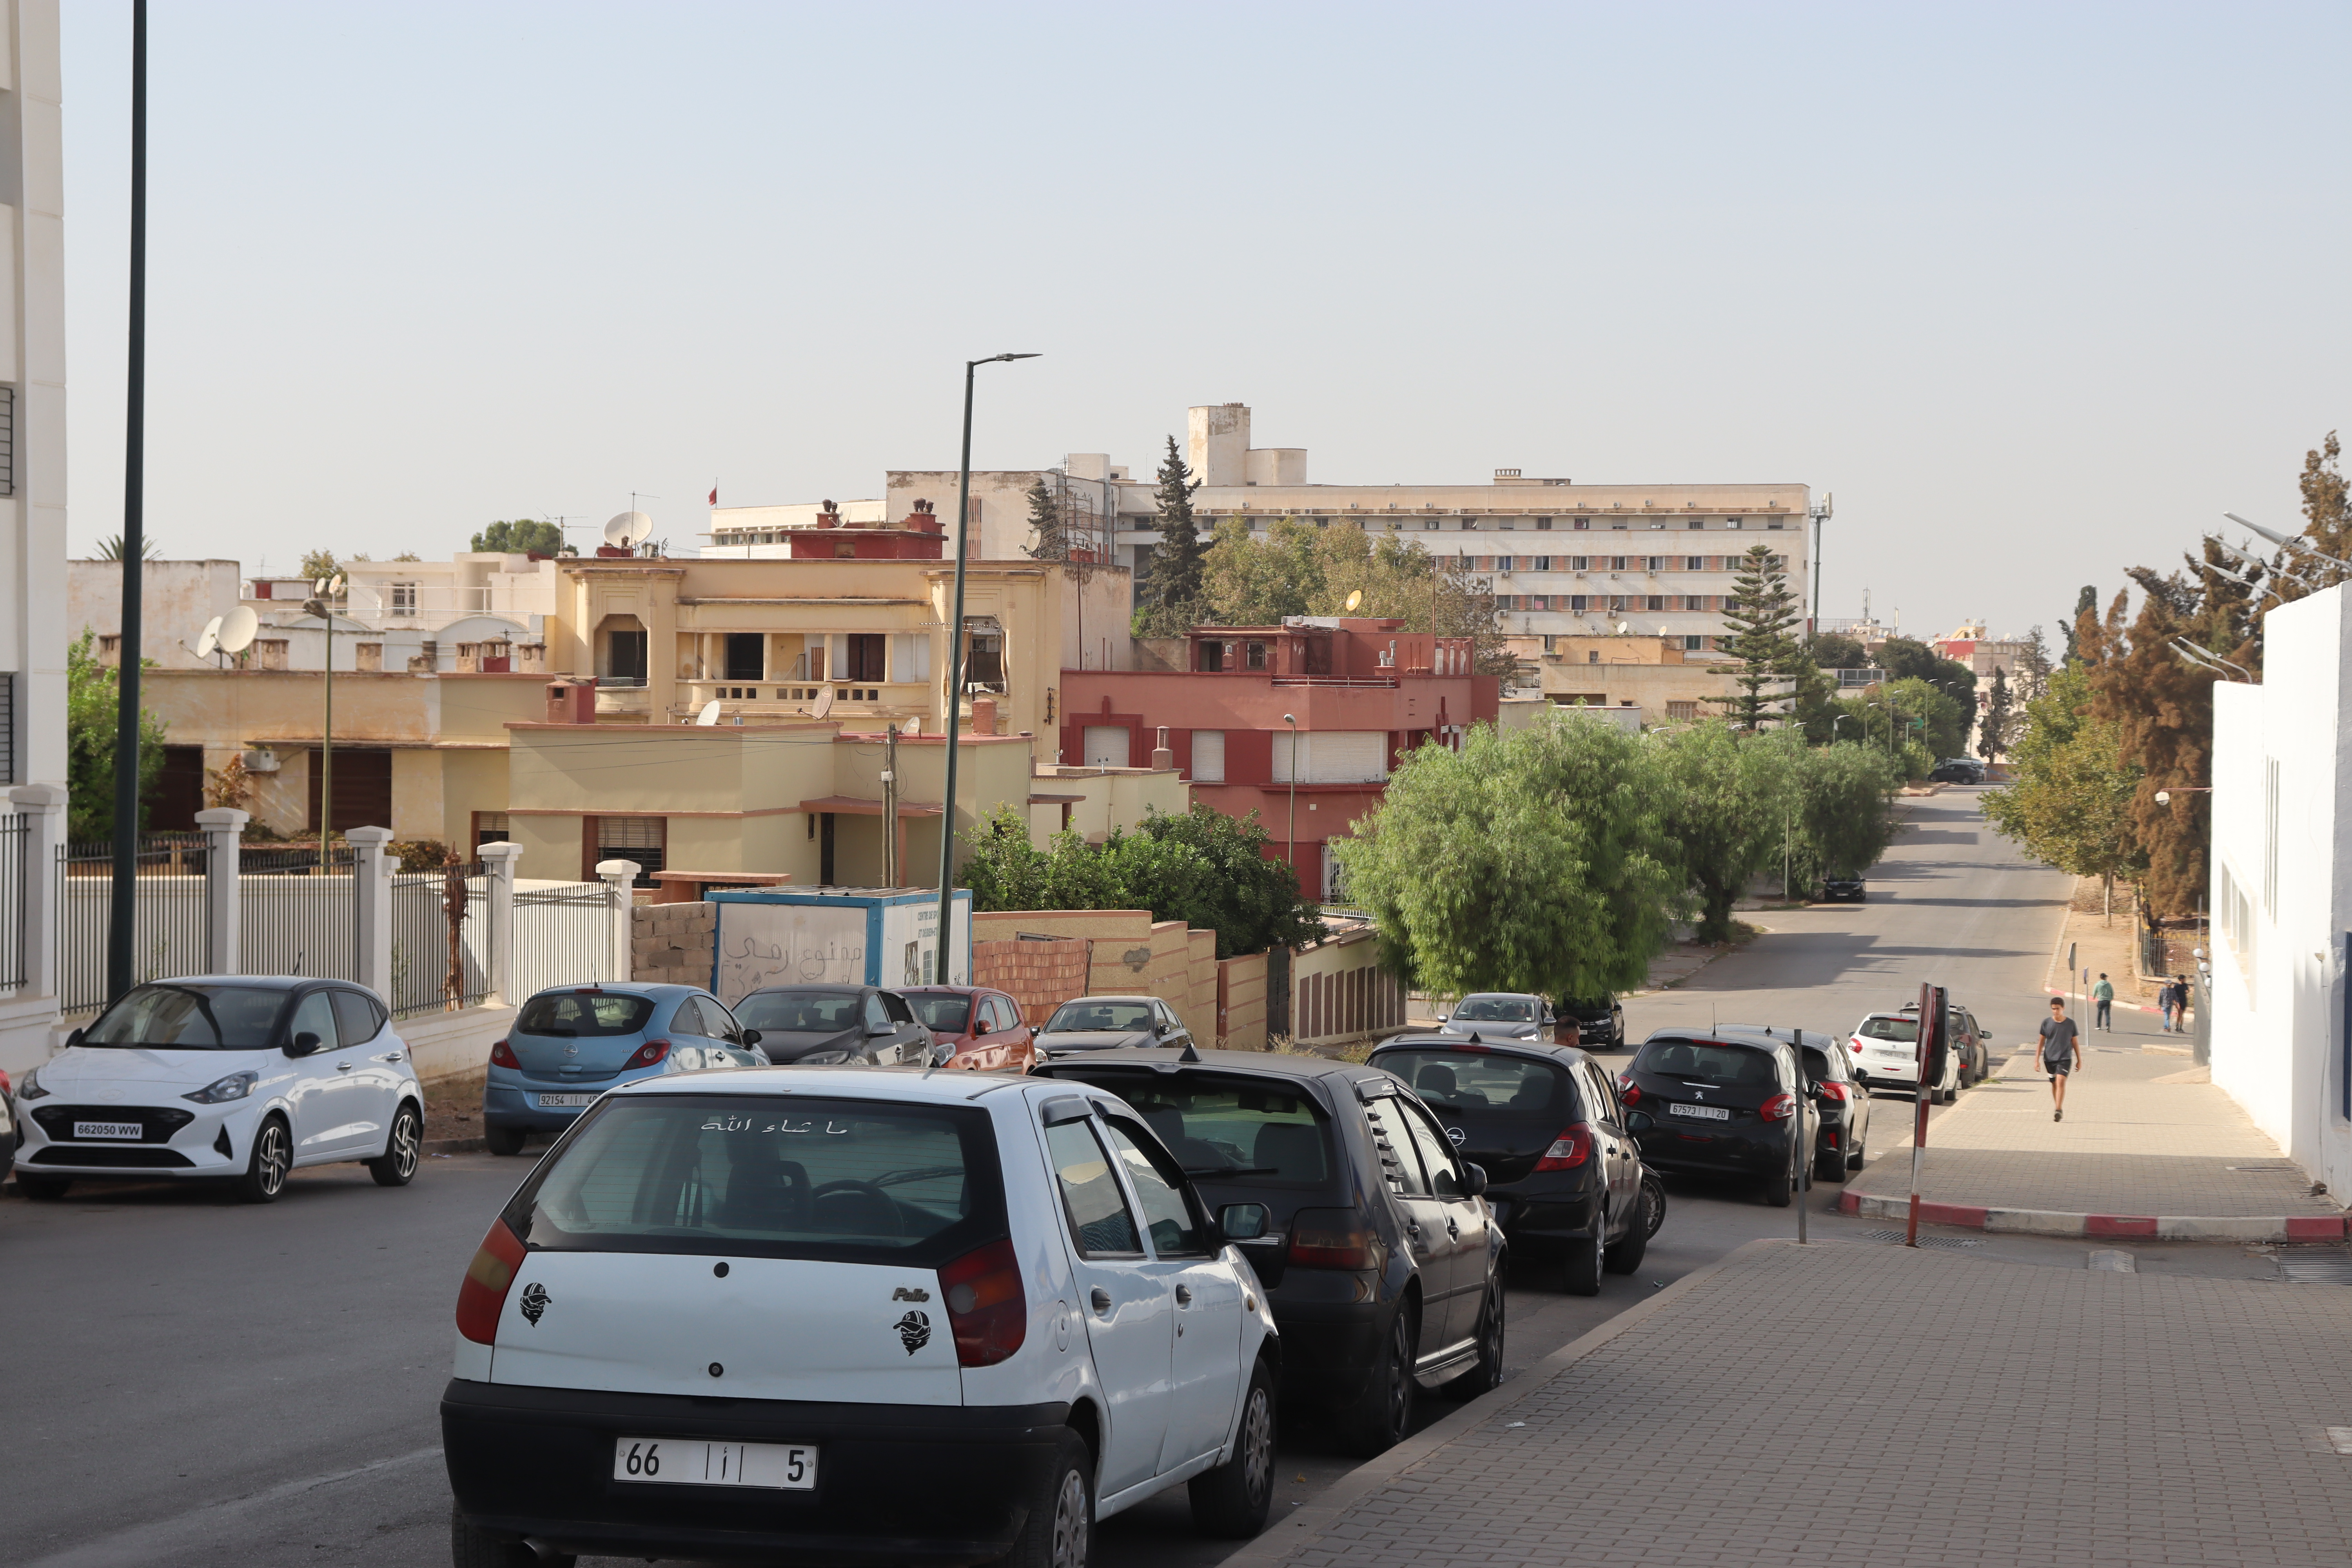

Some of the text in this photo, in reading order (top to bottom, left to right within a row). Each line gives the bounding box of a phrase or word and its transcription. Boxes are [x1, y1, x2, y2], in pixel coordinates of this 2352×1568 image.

[929, 911, 933, 920] DE
[918, 929, 922, 938] ET
[541, 1096, 564, 1105] 92154
[1673, 1105, 1696, 1115] 67573
[1717, 1110, 1726, 1118] 20
[701, 1114, 848, 1134] ما شاء الله
[78, 1125, 140, 1136] 662050 WW
[892, 1287, 929, 1302] Palio
[627, 1443, 659, 1476] 66
[787, 1450, 805, 1482] 5
